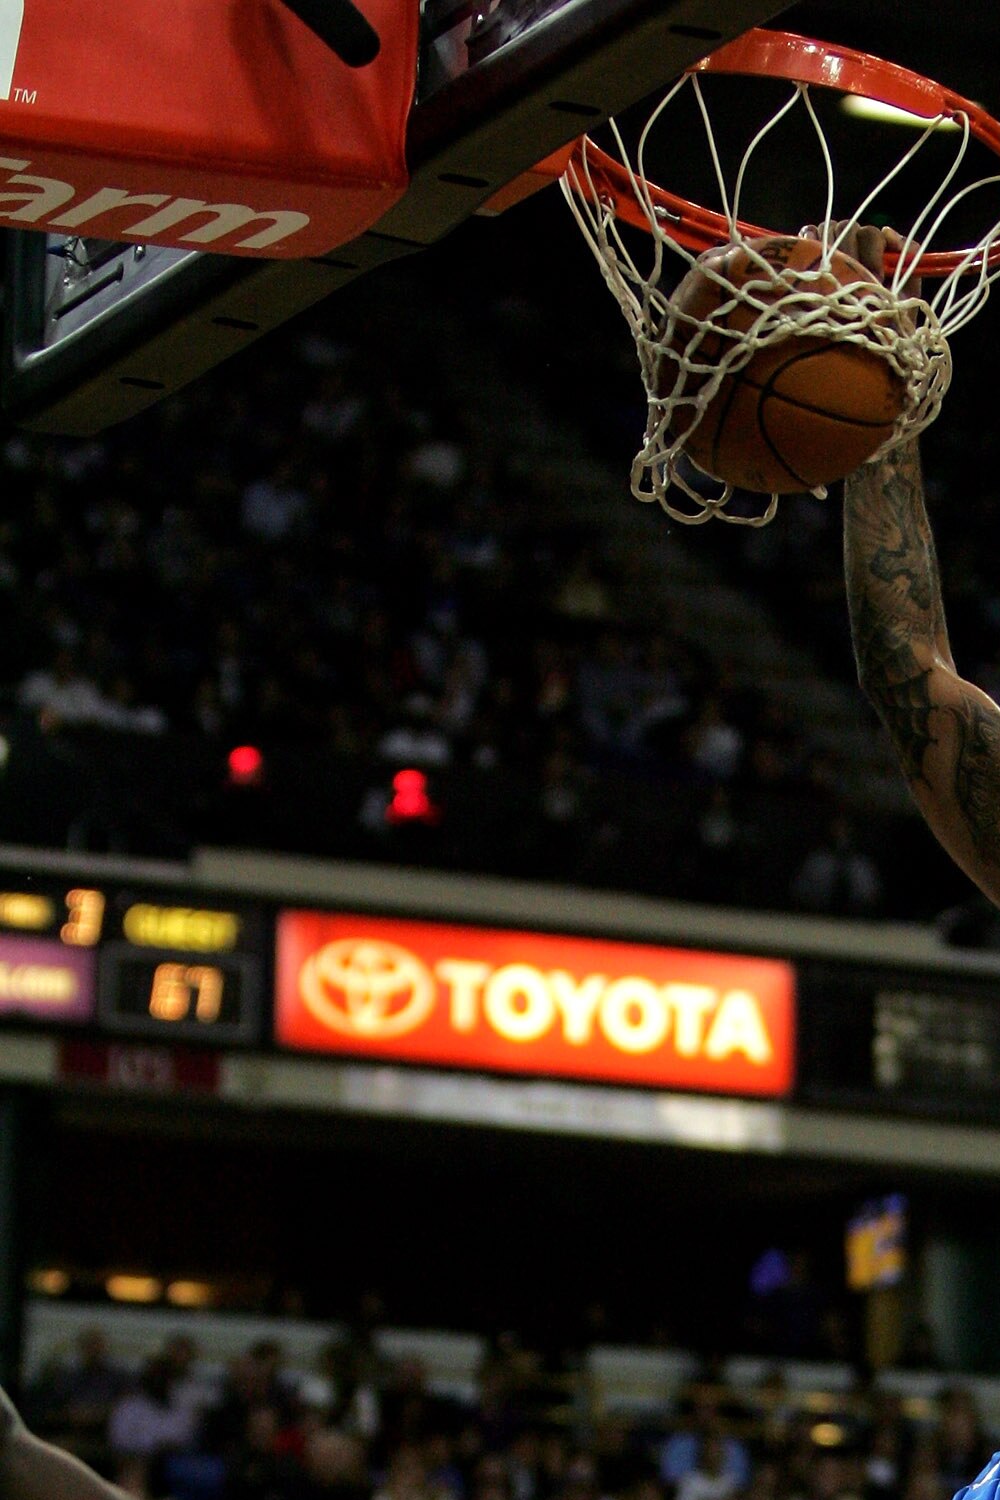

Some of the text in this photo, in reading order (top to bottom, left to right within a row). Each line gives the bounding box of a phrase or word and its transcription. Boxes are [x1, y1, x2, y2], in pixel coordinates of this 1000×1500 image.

[13, 88, 37, 104] TM
[0, 156, 311, 250] arm
[434, 957, 774, 1066] TOYOTA
